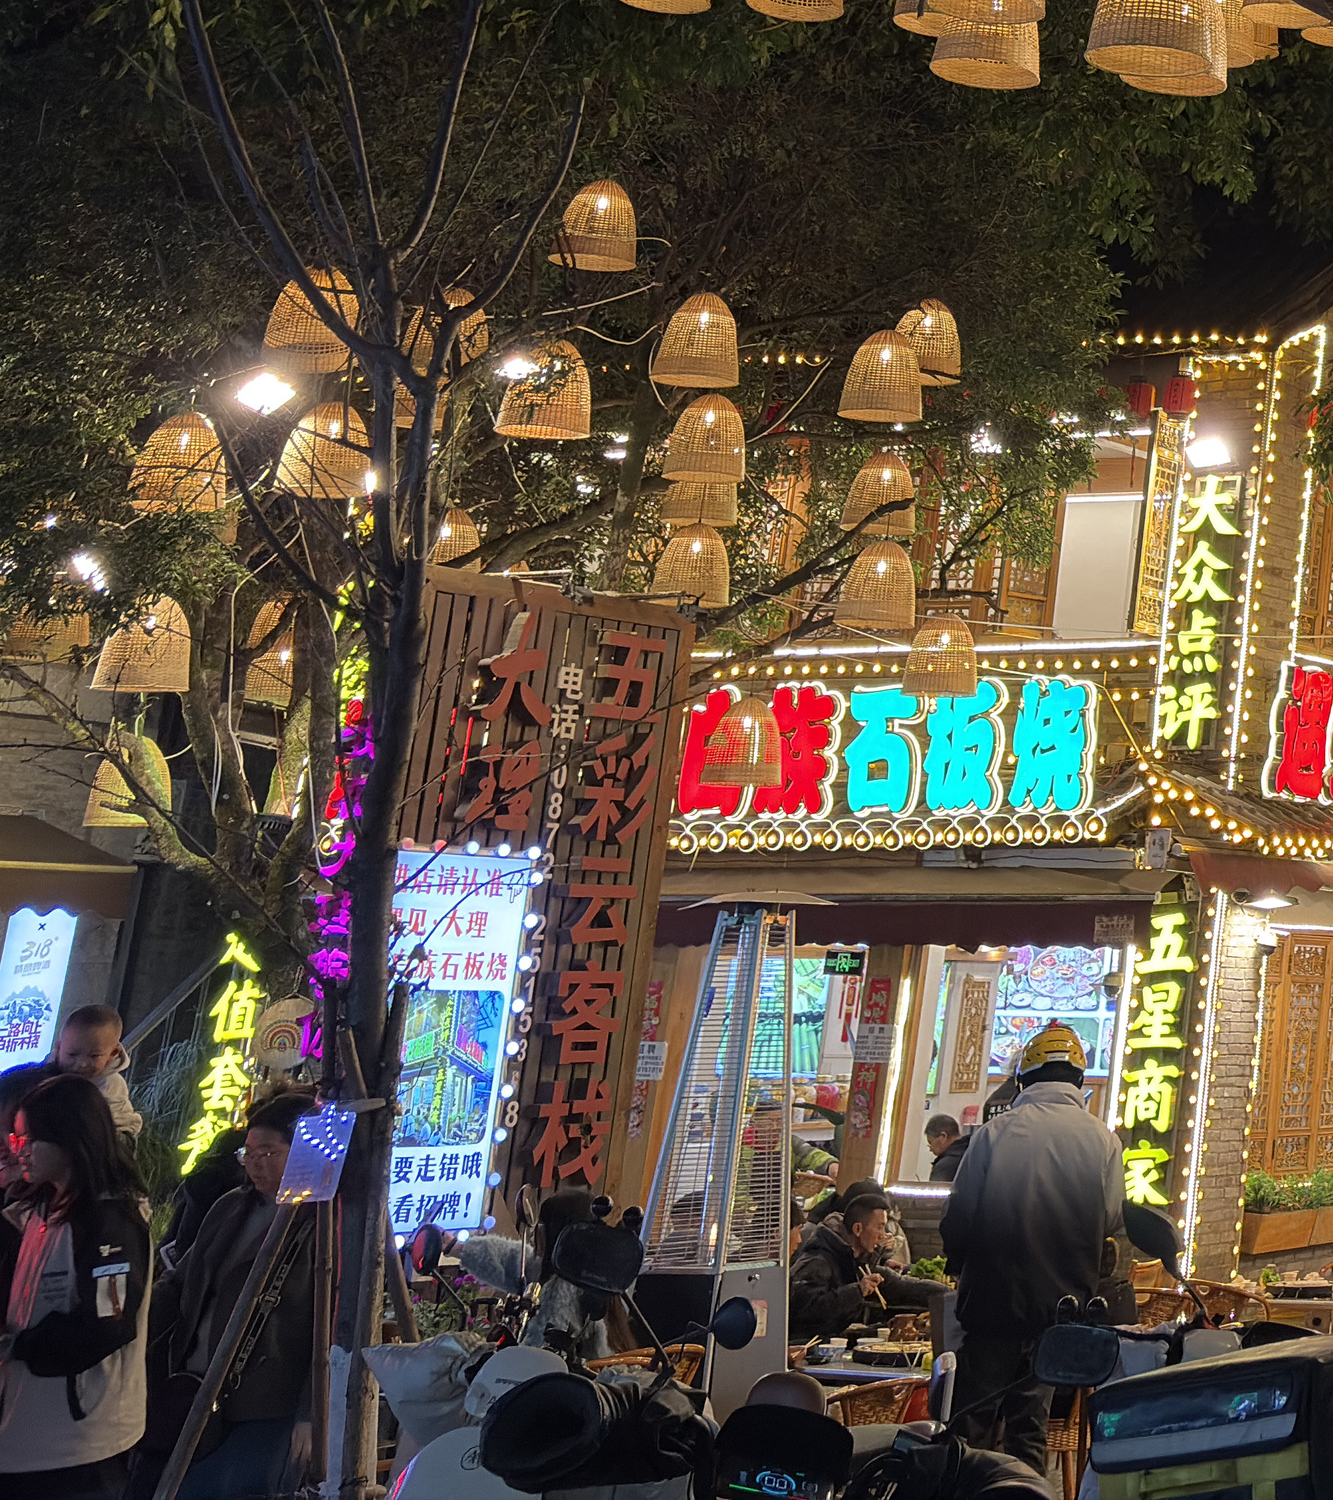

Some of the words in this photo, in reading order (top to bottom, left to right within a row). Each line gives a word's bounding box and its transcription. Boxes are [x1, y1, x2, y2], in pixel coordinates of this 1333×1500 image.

[464, 612, 552, 830] 大理
[1159, 474, 1241, 750] 大众点评
[20, 938, 53, 964] 318
[533, 632, 666, 1188] 五彩云客栈
[1121, 912, 1195, 1206] 五星商家
